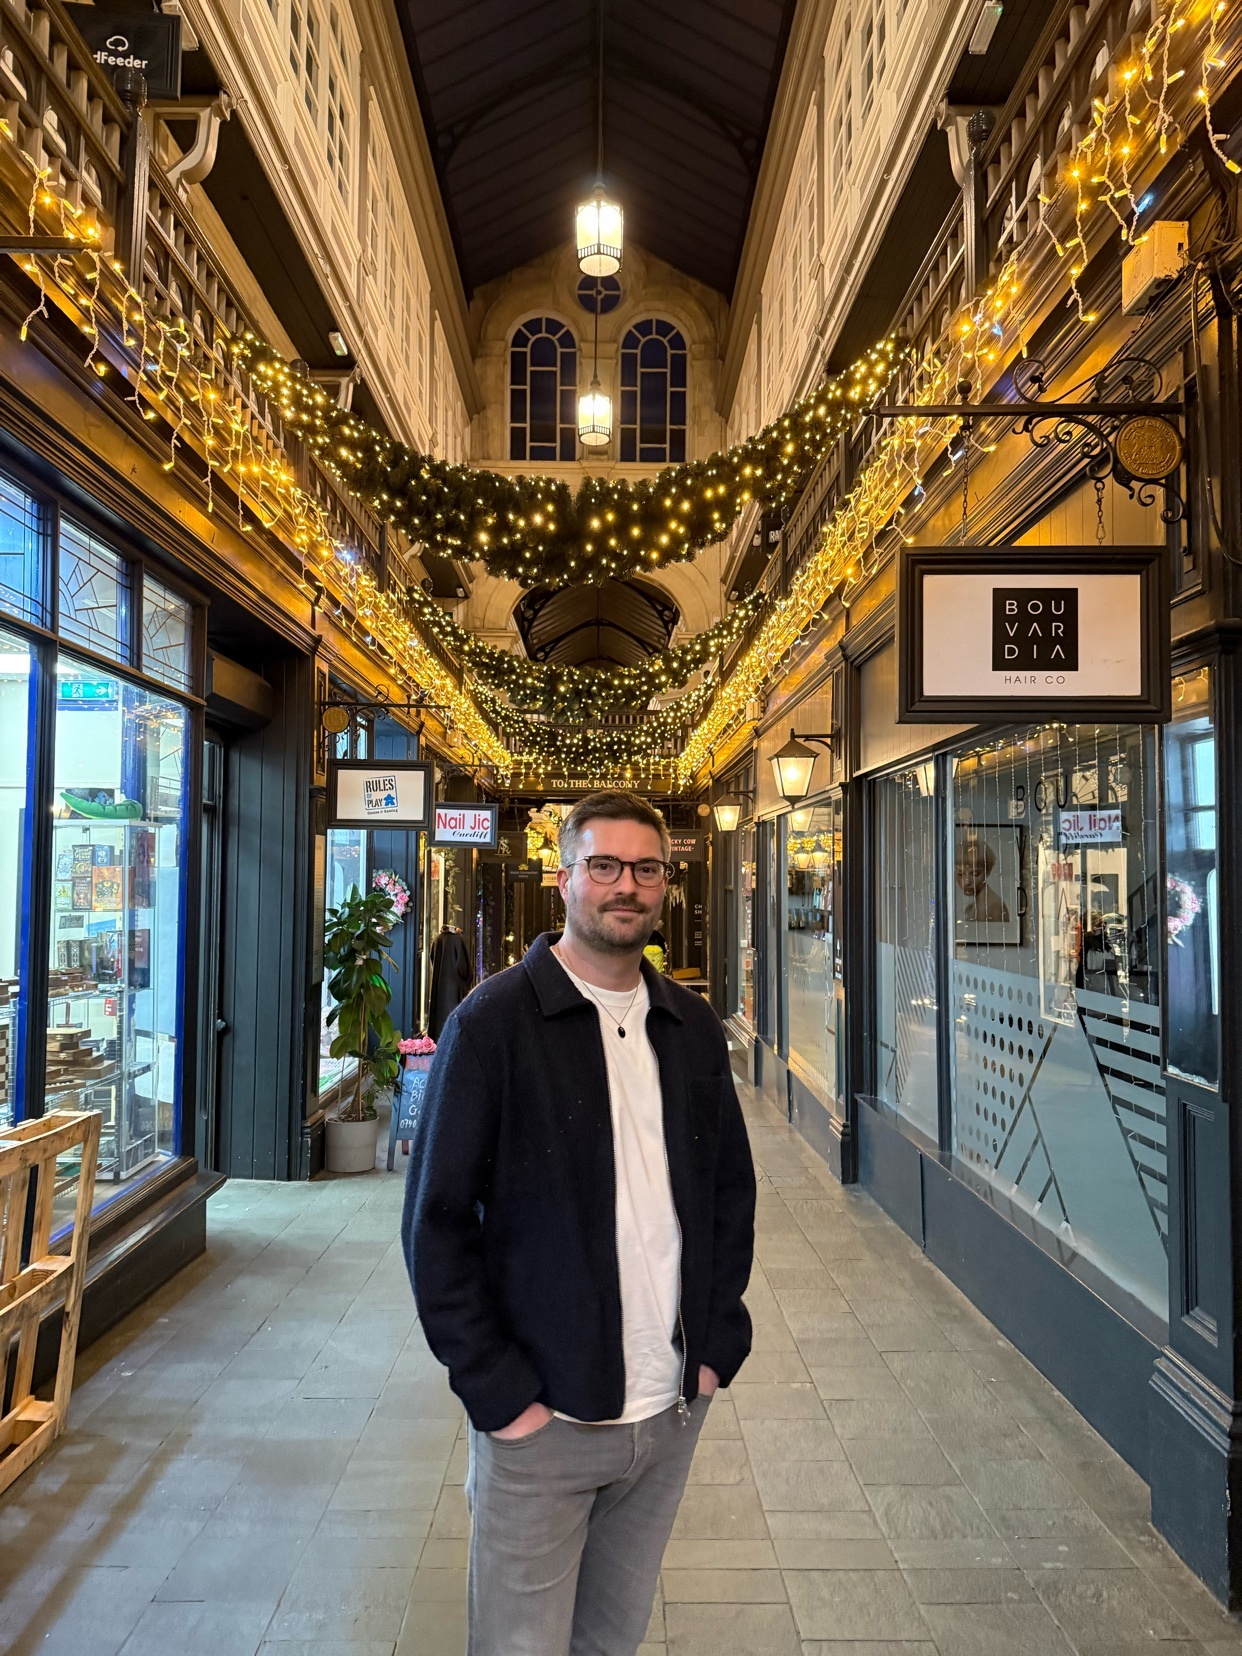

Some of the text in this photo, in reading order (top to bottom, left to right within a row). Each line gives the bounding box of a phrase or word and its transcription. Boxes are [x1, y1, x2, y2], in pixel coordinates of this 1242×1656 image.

[93, 51, 148, 69] dFeeder
[1005, 600, 1066, 616] BOU
[1005, 622, 1065, 638] VAR
[1004, 644, 1066, 660] DIA
[1004, 675, 1066, 685] HAIR CO
[365, 778, 394, 793] RULES
[551, 779, 641, 789] TO THE BALCONY
[367, 798, 383, 808] PLAY
[437, 812, 490, 831] Nail Jic
[452, 830, 489, 839] Cardiff
